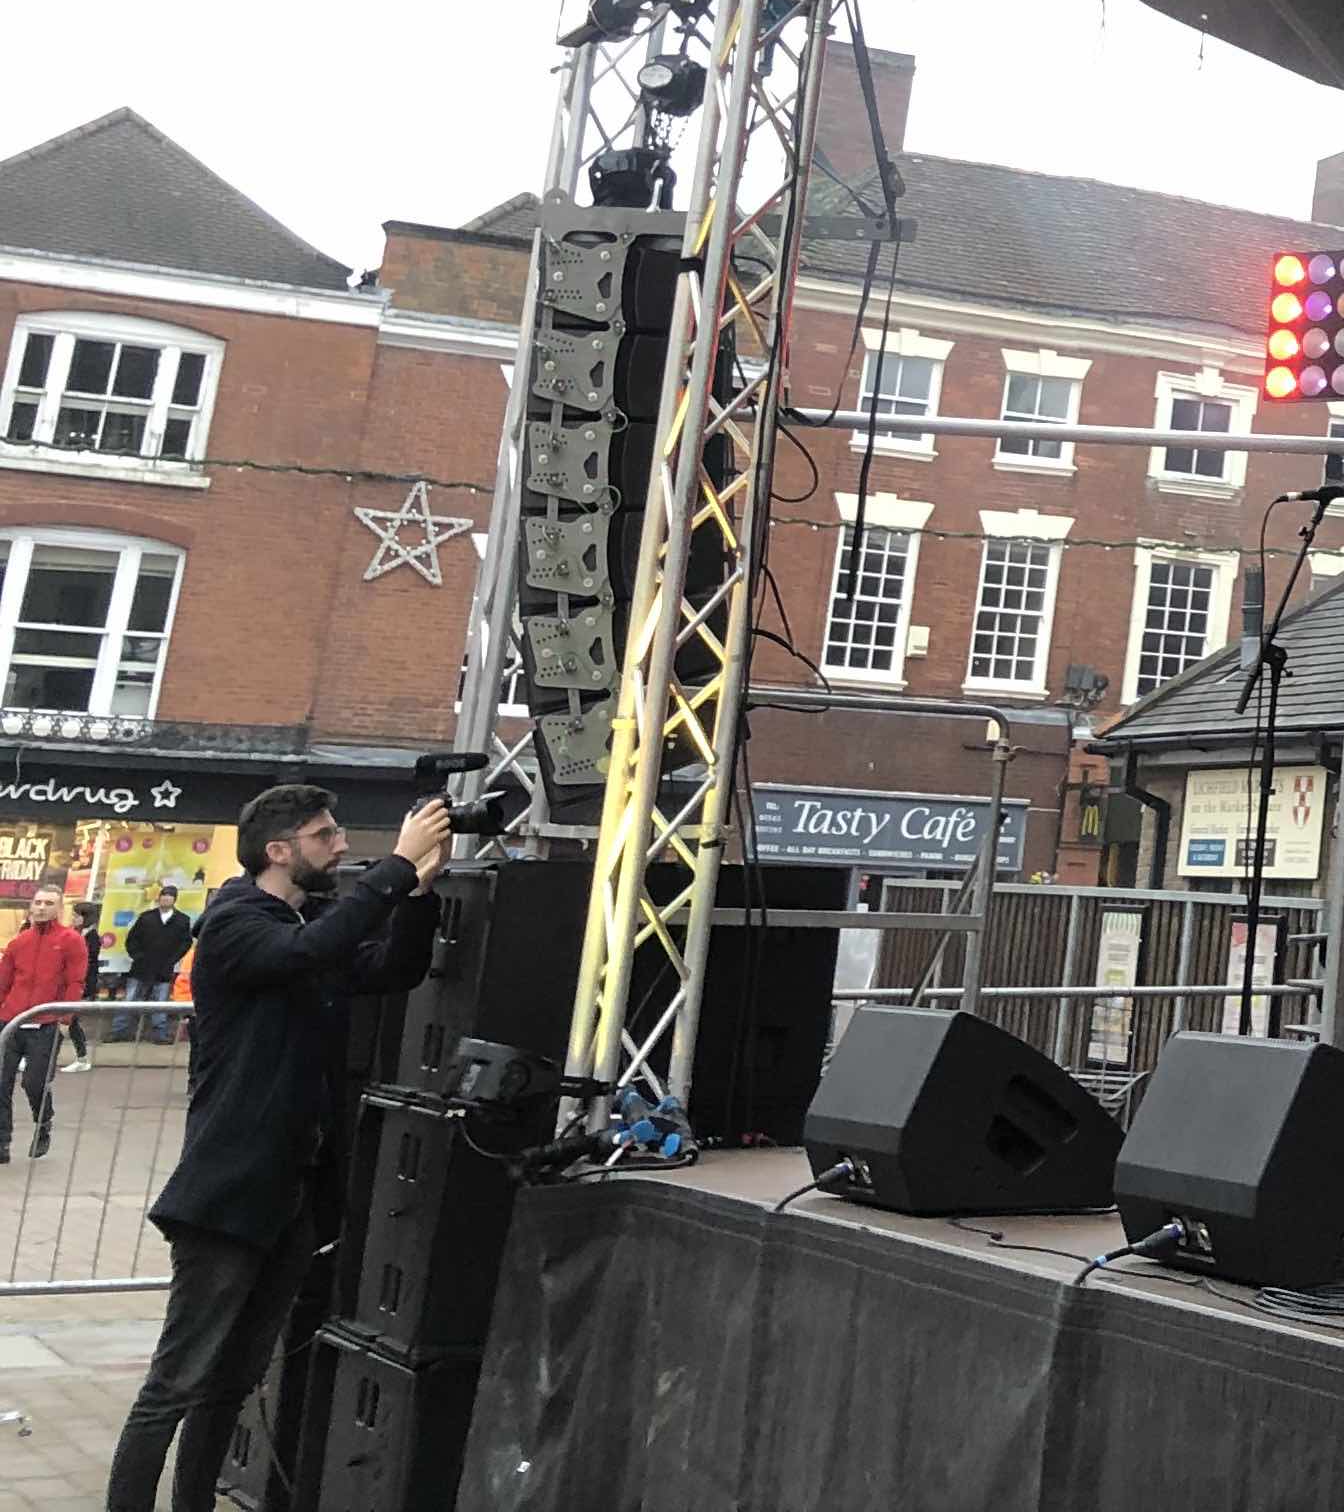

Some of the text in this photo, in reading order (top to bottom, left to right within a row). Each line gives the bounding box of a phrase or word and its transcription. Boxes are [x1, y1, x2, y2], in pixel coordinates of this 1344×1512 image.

[0, 778, 139, 813] rdrug
[792, 800, 890, 844] Tasty
[900, 807, 976, 848] Café
